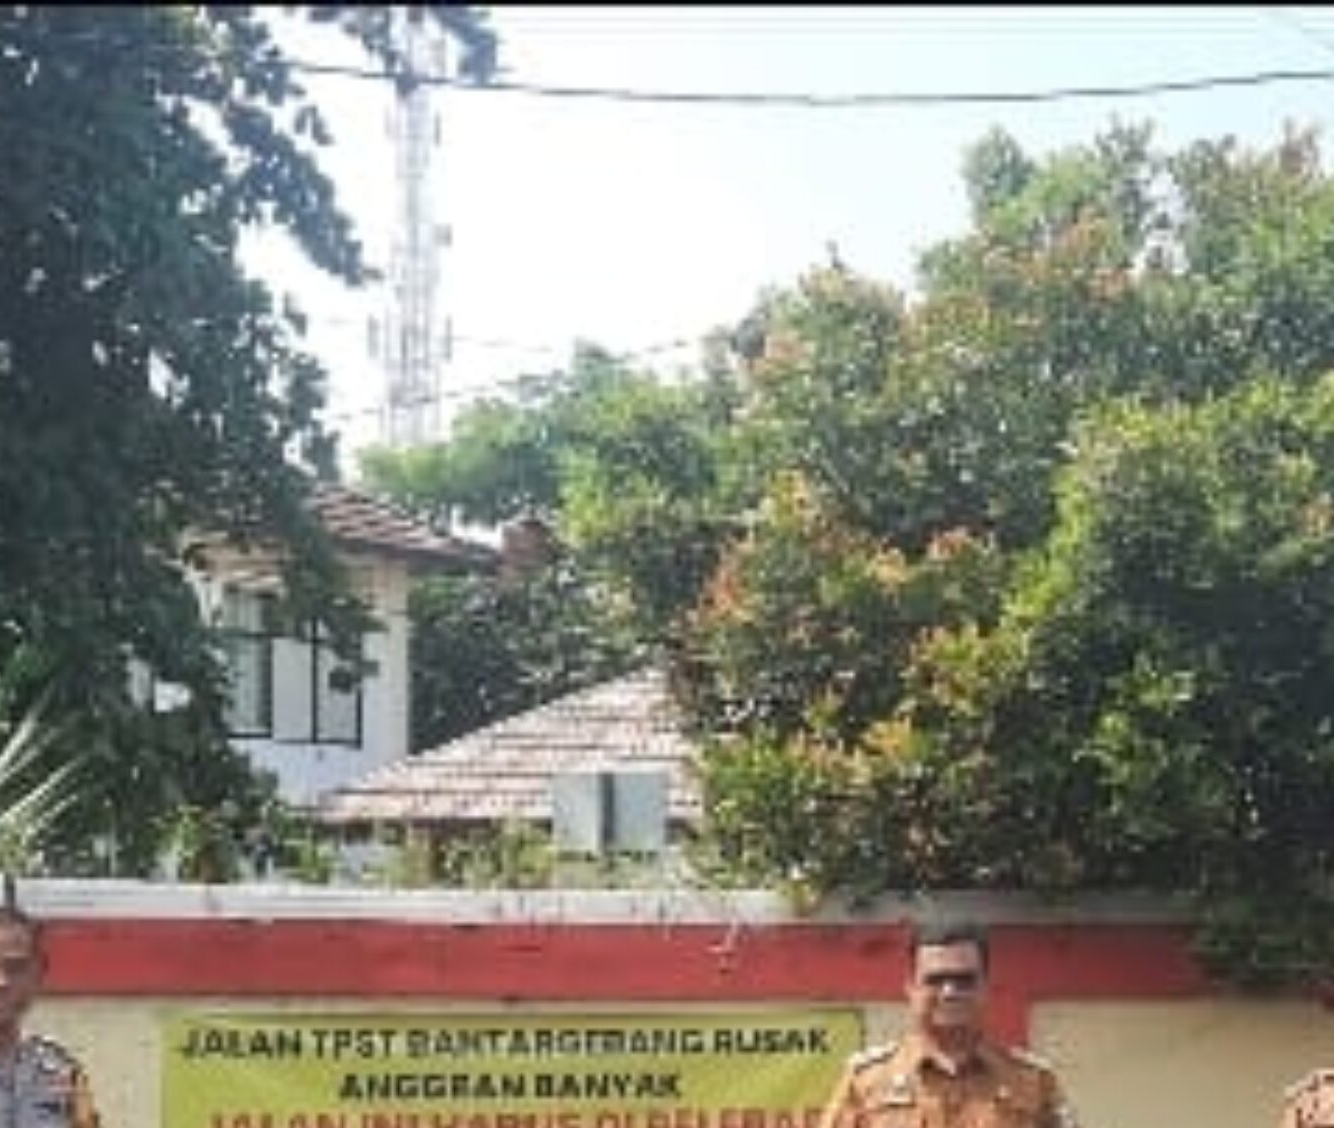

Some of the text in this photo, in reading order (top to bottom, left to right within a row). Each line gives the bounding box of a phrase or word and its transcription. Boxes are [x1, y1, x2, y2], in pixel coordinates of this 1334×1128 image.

[181, 1029, 302, 1059] JALAN
[310, 1028, 398, 1060] TPST
[714, 1027, 830, 1055] RUSAK
[535, 1072, 683, 1099] BANYAK
